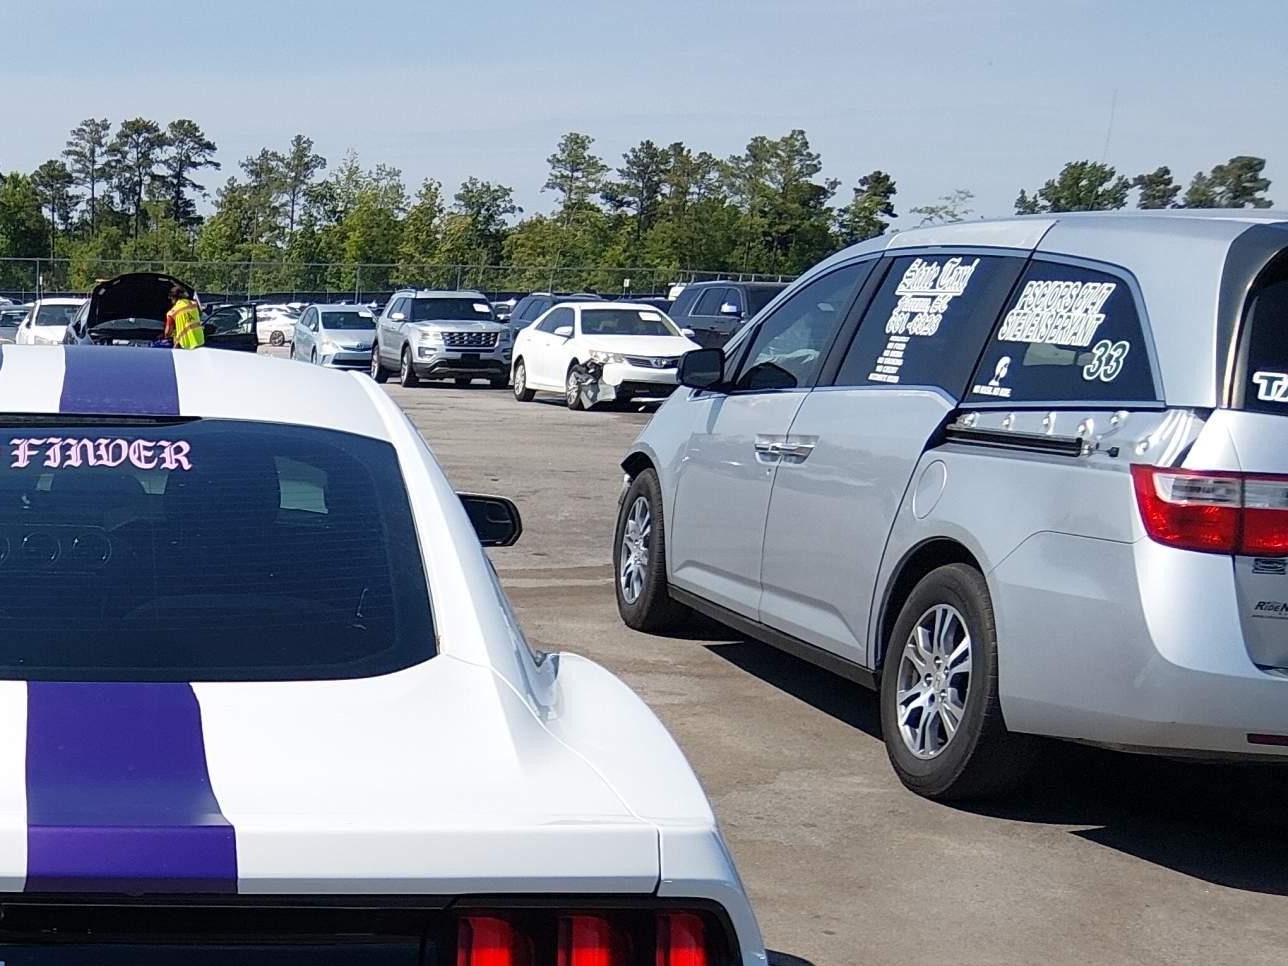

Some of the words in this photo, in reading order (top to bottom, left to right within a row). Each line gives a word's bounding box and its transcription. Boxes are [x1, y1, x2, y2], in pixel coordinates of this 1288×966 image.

[998, 309, 1057, 343] STEVENS
[1043, 313, 1106, 347] BRYANT
[1083, 339, 1130, 382] 33
[10, 437, 192, 471] FINDER
